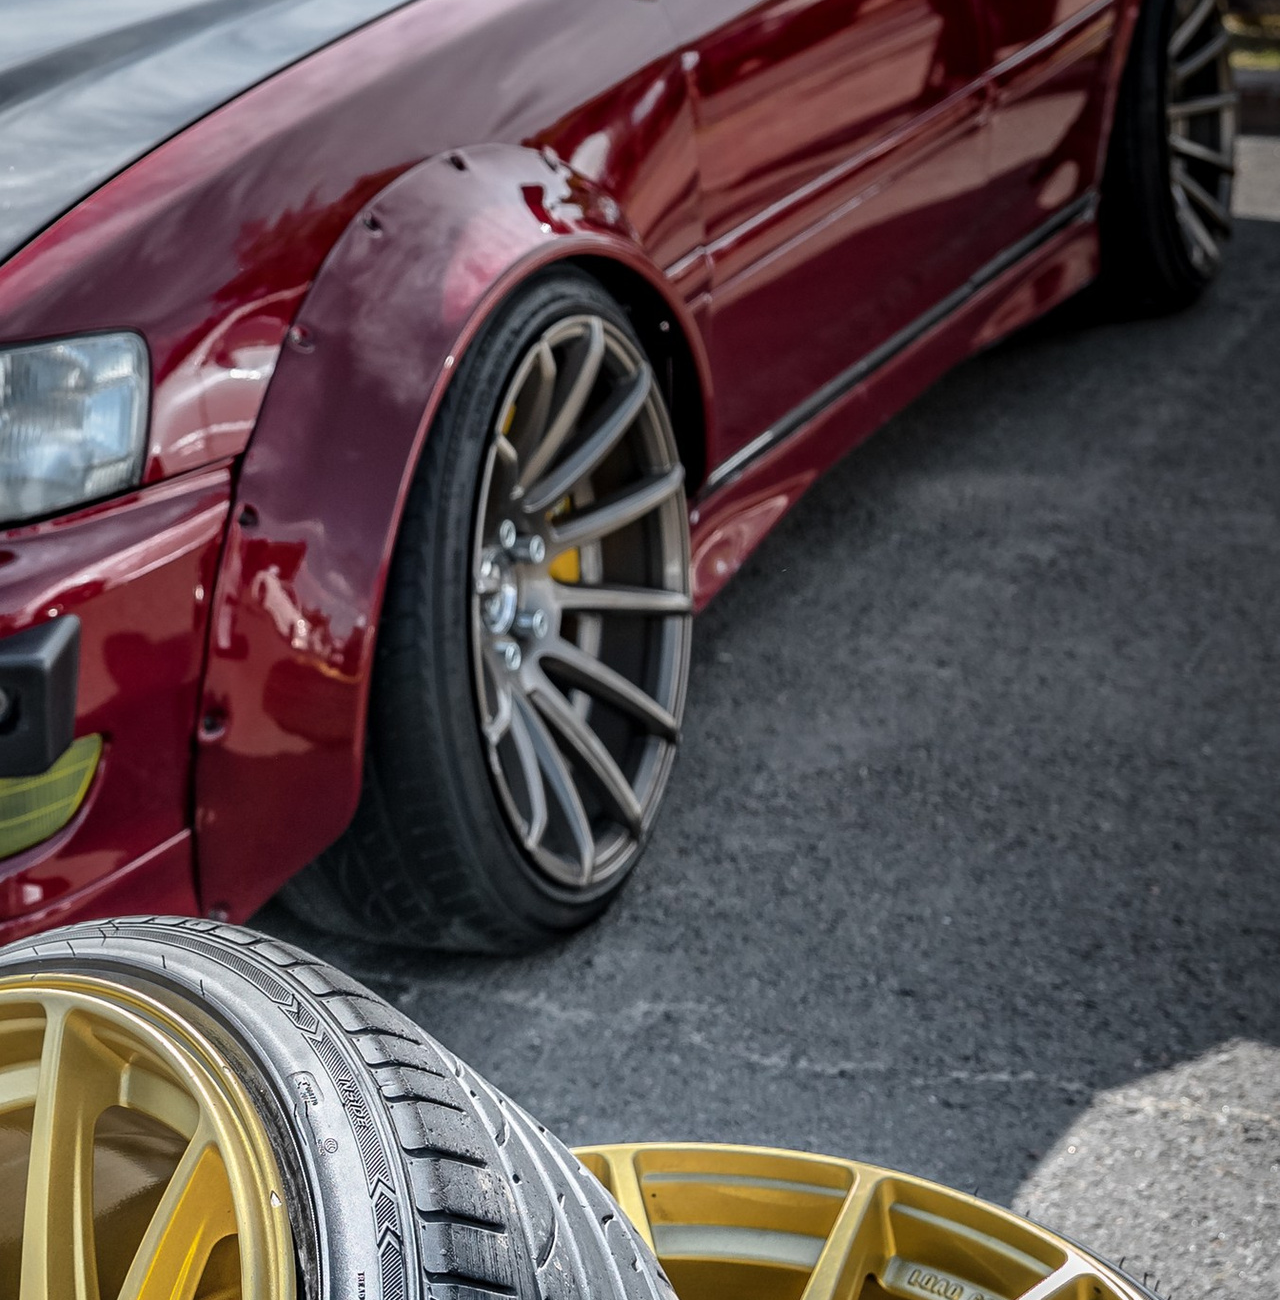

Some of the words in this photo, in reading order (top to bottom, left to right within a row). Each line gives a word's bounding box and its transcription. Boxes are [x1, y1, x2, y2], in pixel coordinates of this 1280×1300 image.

[338, 1075, 368, 1130] INSIDE
[357, 1271, 365, 1300] TREAD
[908, 1269, 964, 1300] LOAD
